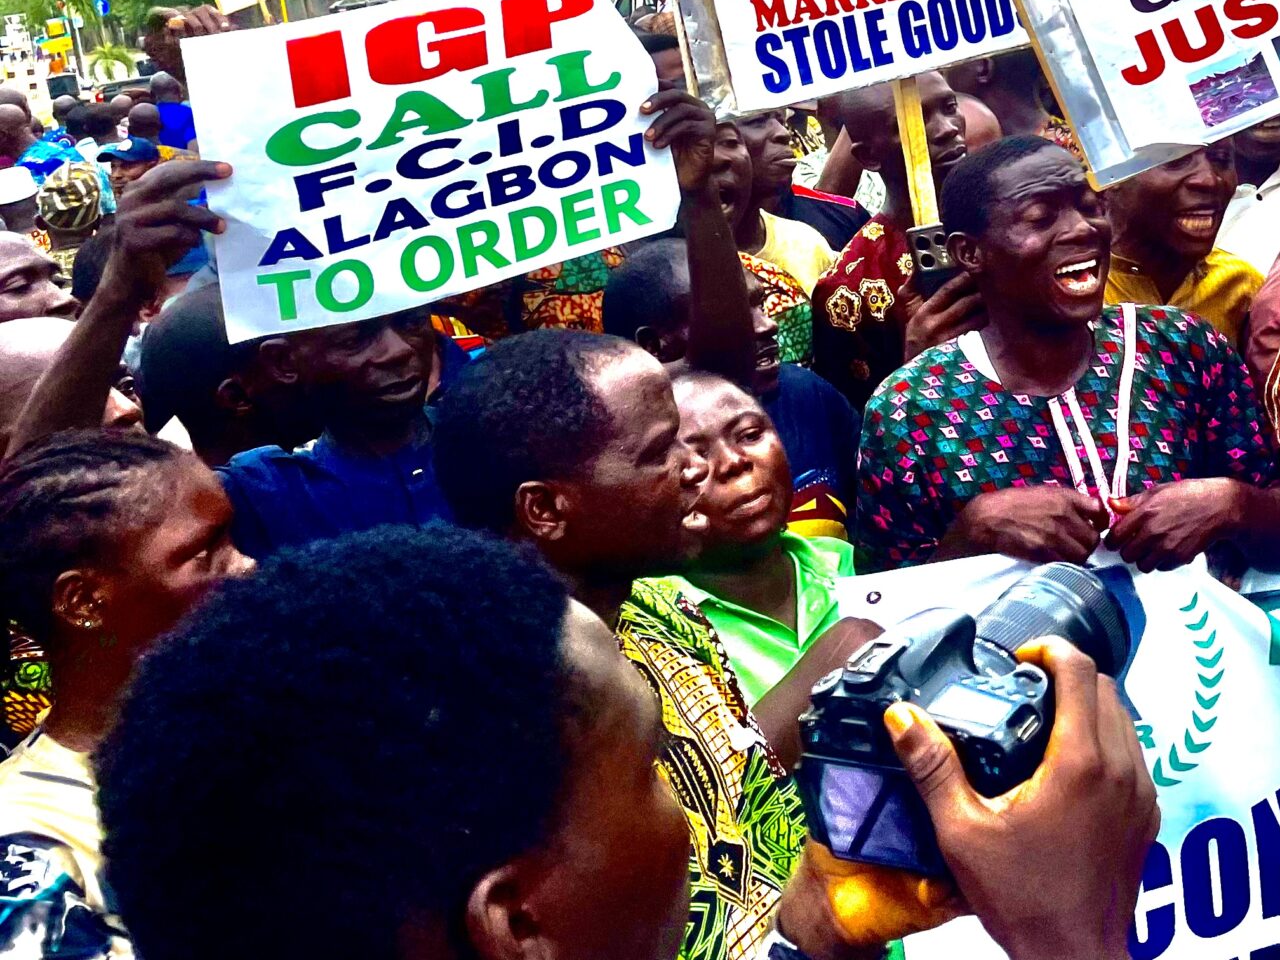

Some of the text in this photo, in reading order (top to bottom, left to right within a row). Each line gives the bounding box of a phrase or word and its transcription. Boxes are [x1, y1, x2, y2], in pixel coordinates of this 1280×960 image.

[265, 50, 622, 167] CALL
[755, 8, 896, 94] STOLE
[257, 132, 647, 267] ALAGBON
[294, 99, 627, 211] F.C.I.D
[256, 178, 654, 322] TO ORDER
